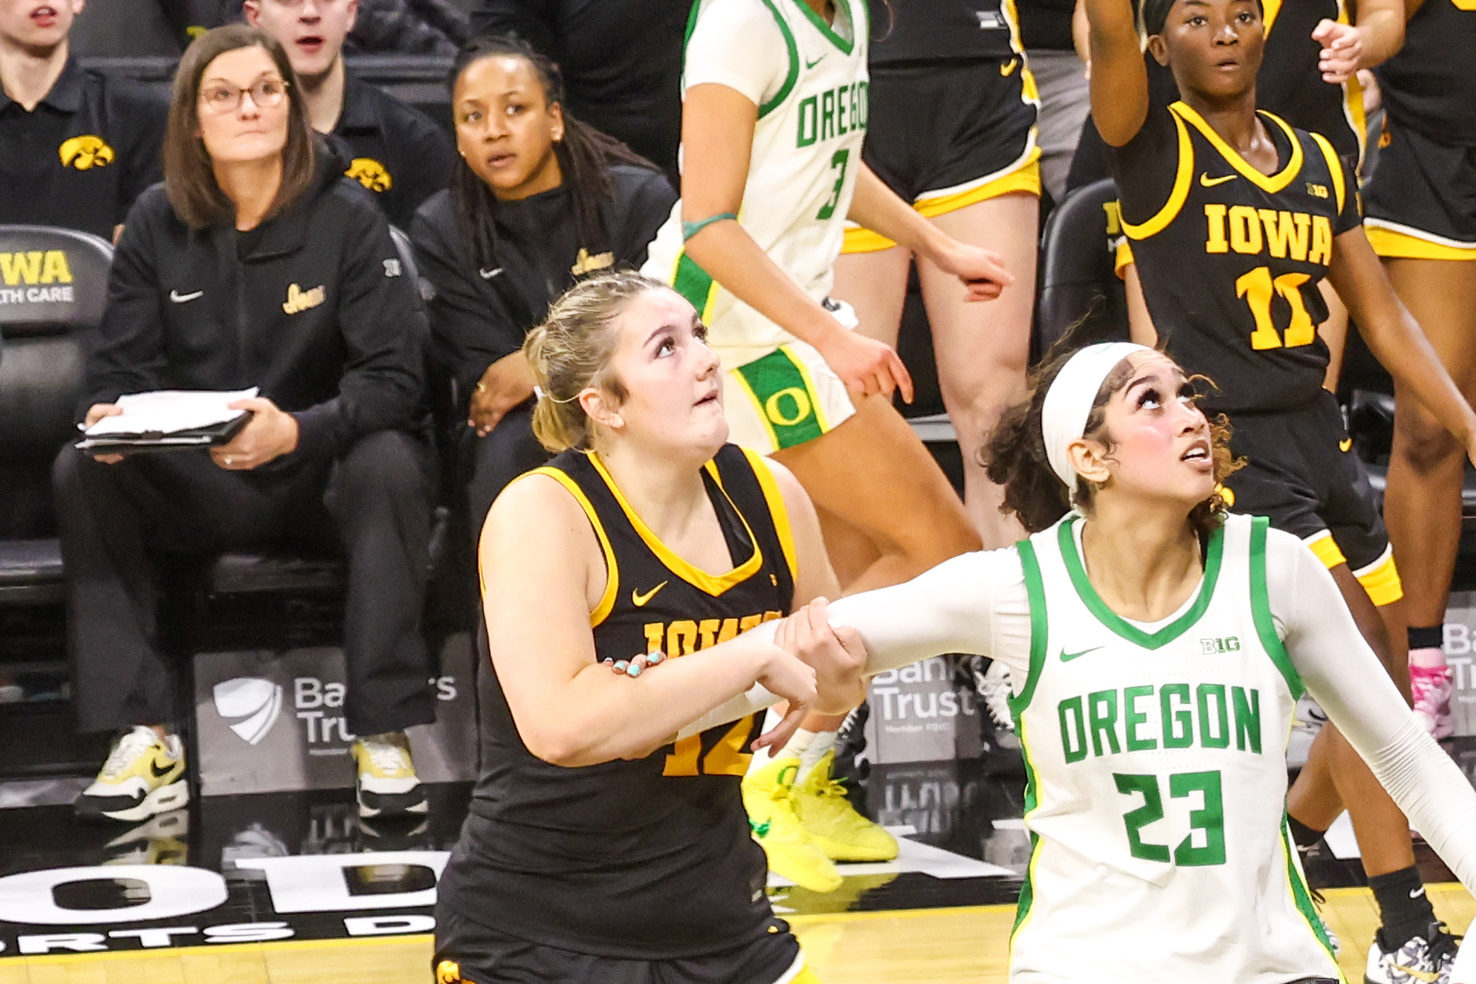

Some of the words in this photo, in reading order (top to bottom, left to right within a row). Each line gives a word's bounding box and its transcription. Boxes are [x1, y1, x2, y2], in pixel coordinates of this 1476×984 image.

[815, 149, 849, 221] 3
[1204, 204, 1323, 267] IOWA
[26, 285, 75, 303] CARE
[1236, 266, 1316, 352] 11
[644, 610, 783, 659] IOW
[872, 685, 975, 722] Trust
[1058, 683, 1263, 765] OREGON
[1112, 769, 1227, 867] 23
